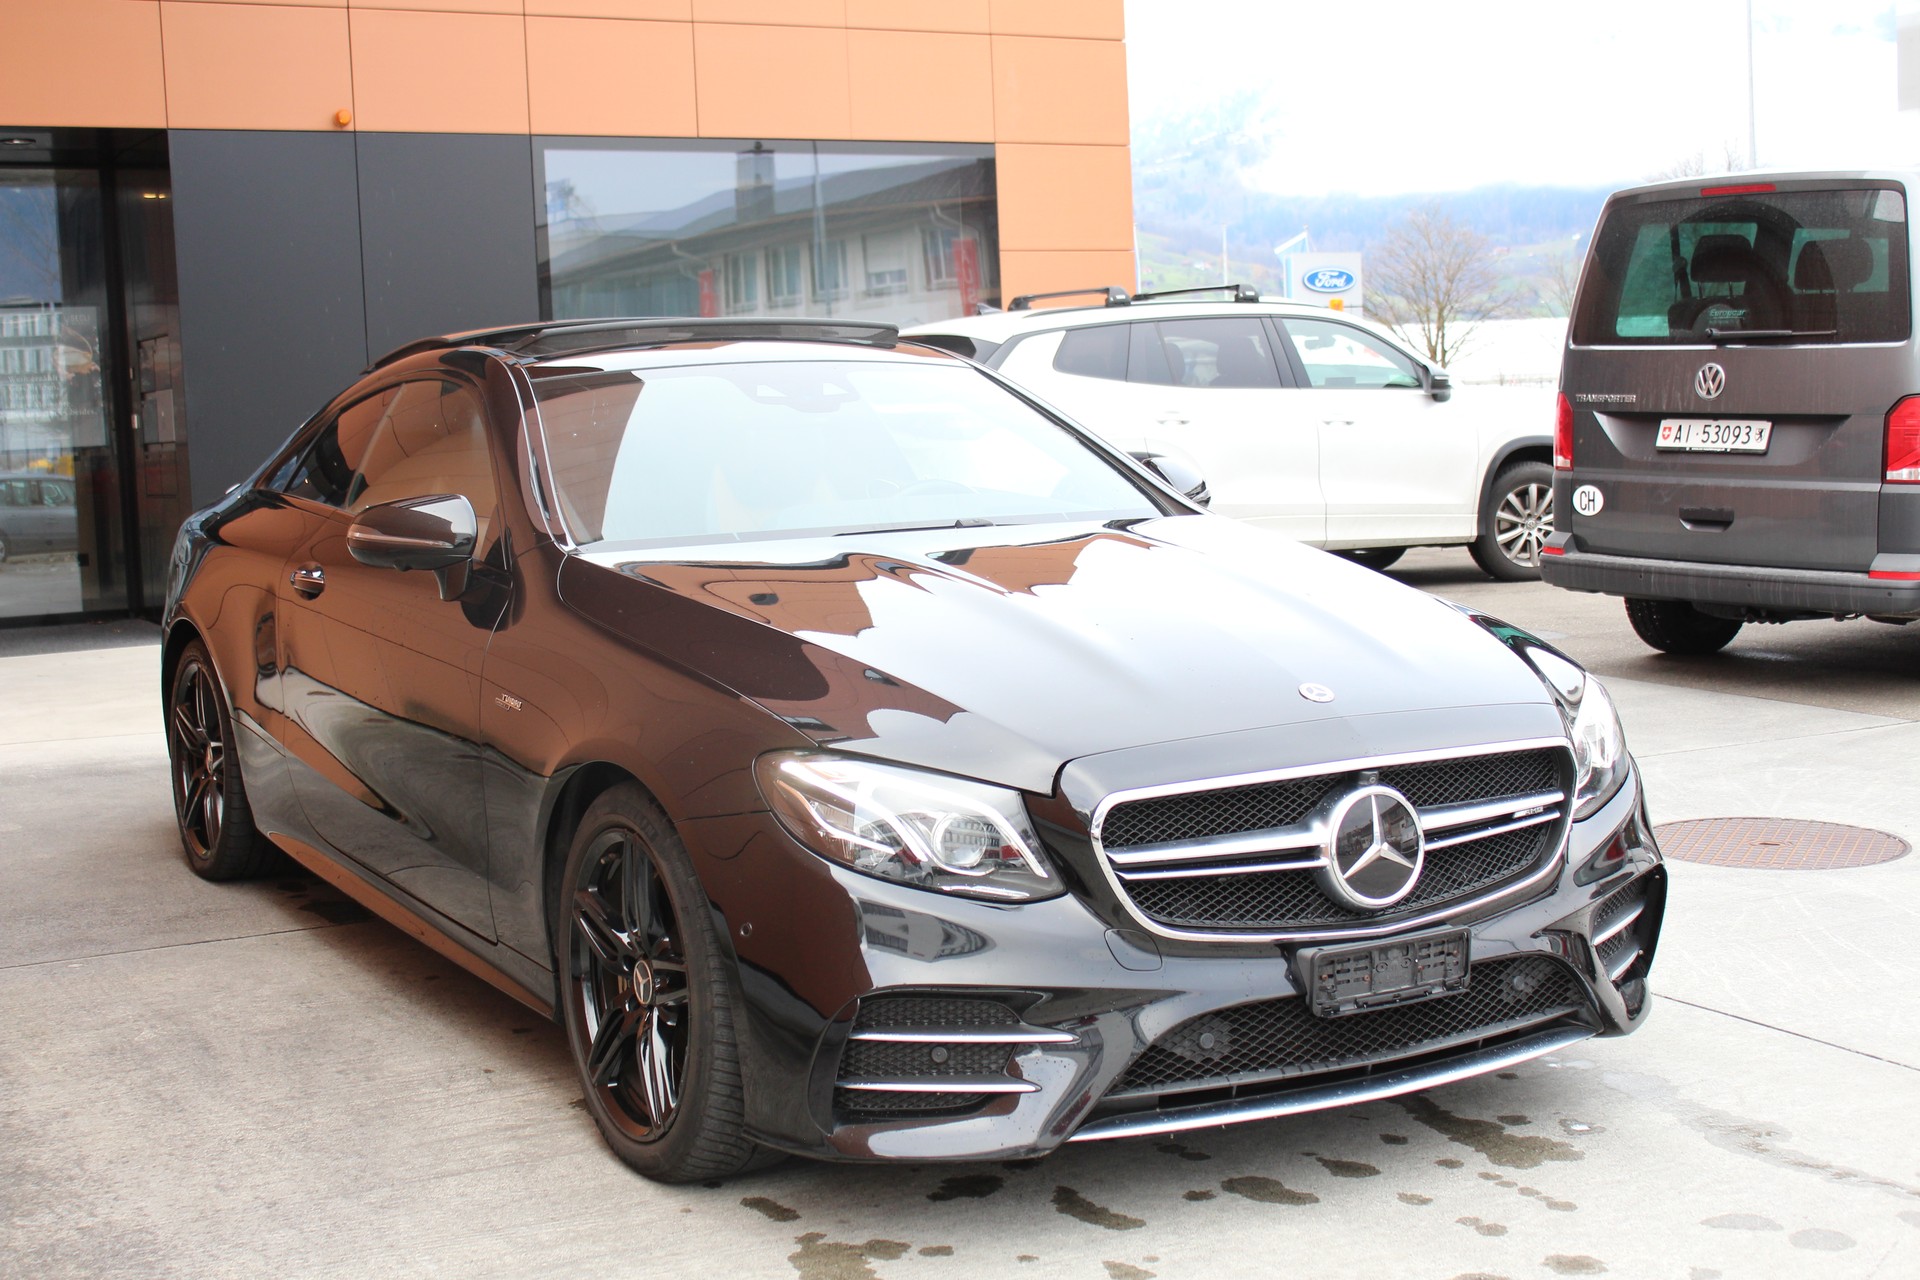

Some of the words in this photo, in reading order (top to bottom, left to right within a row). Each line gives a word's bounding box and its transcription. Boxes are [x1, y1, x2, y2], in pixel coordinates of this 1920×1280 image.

[1314, 270, 1347, 288] Ford
[1709, 309, 1746, 318] Europcar
[1575, 393, 1637, 403] TRANSPORTER
[1579, 490, 1596, 512] CH
